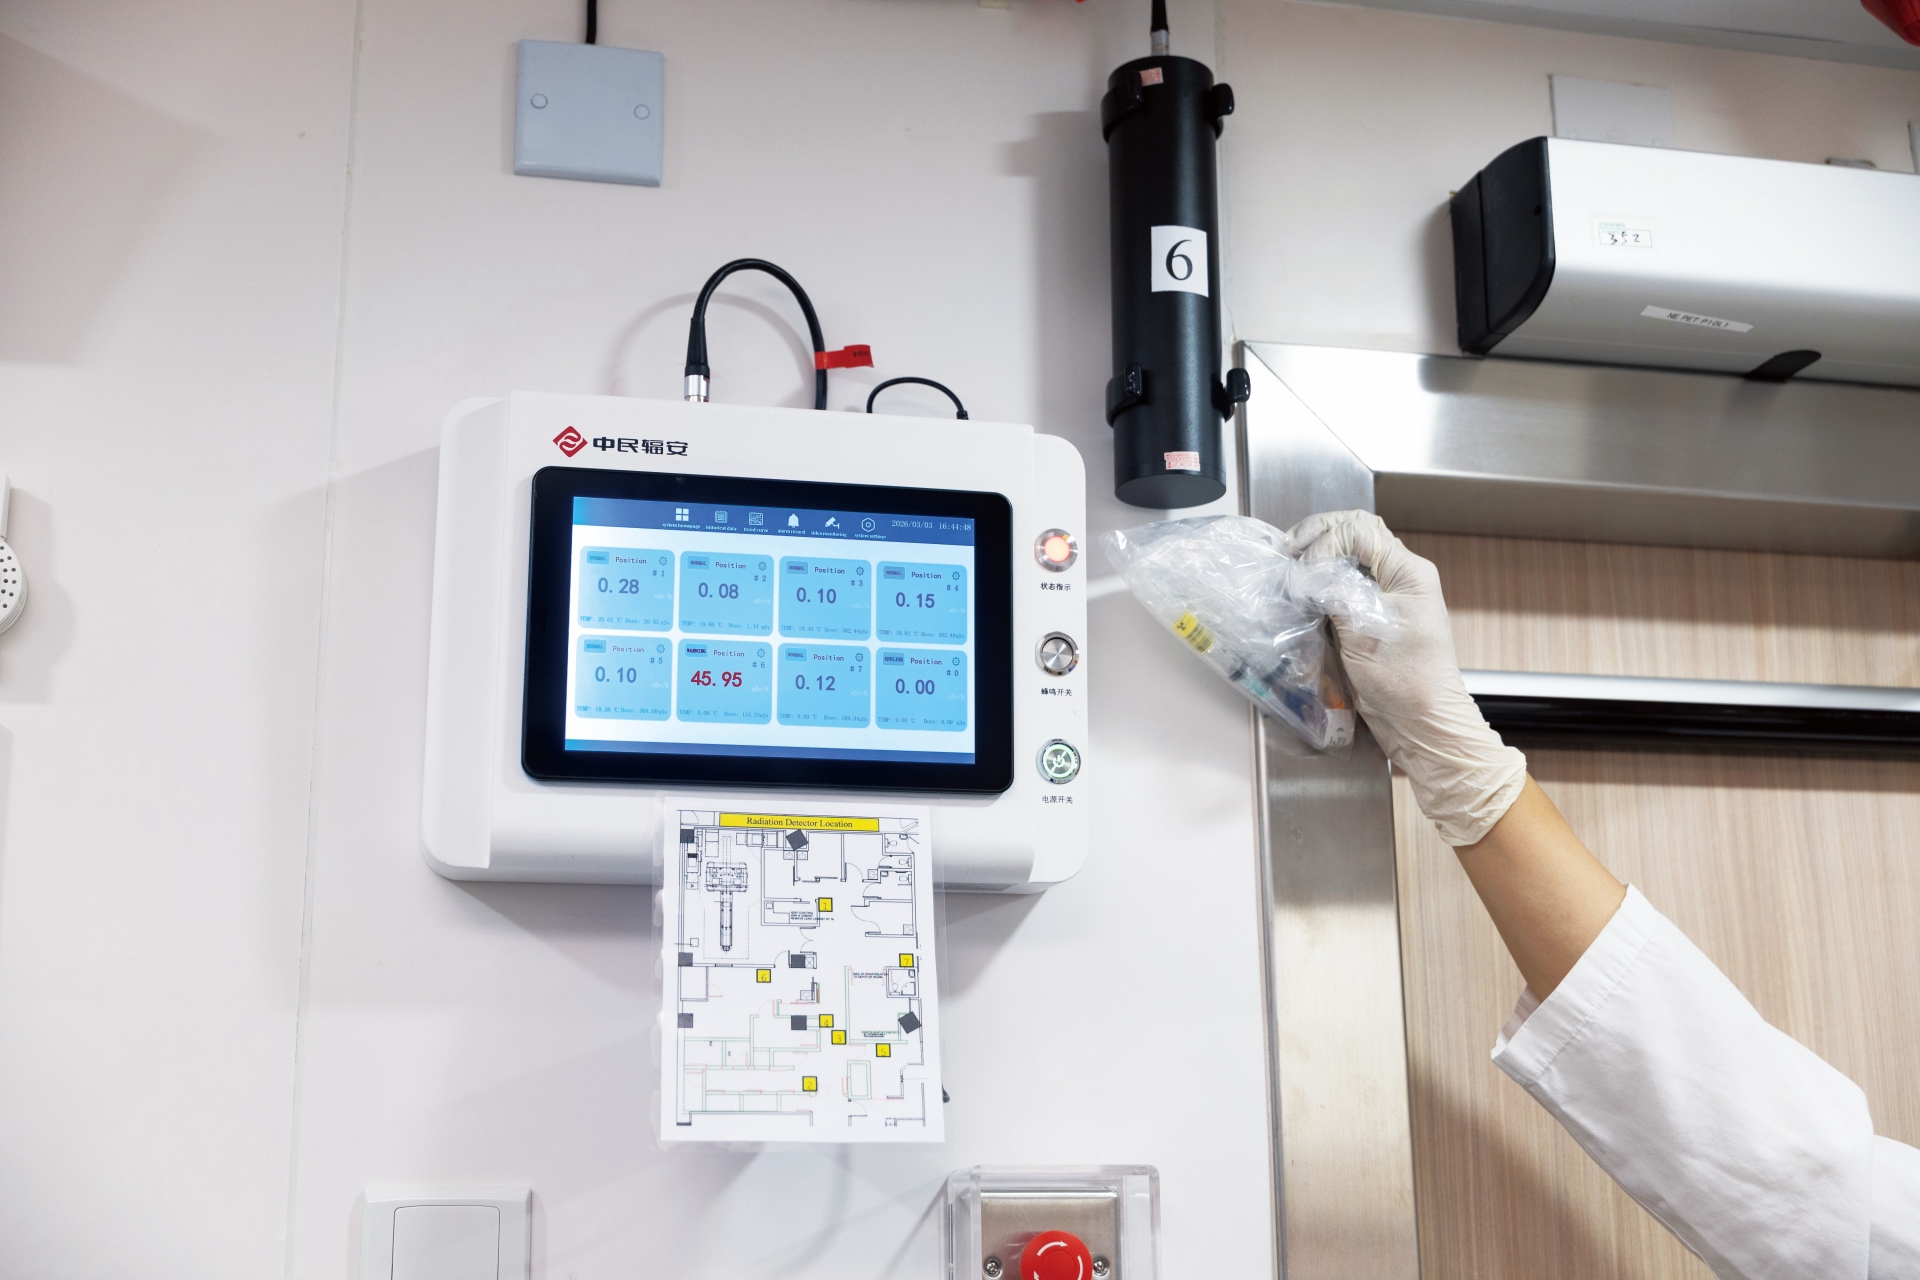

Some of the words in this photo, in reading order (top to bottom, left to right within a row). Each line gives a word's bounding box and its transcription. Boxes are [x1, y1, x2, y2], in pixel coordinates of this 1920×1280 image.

[1166, 239, 1193, 281] 6
[1680, 314, 1699, 322] PET
[593, 437, 688, 456] 中民辐安
[891, 520, 932, 529] 2026/03/03
[939, 523, 971, 531] 16:44:48
[598, 577, 639, 594] 0.28
[698, 582, 739, 599] 0.08
[1040, 582, 1071, 591] 状态指示
[796, 587, 836, 604] 0.10
[896, 592, 935, 608] 0.15
[595, 666, 637, 683] 0.10
[691, 671, 742, 687] 45.95
[795, 674, 835, 691] 0.12
[895, 679, 935, 695] 0.00
[1041, 687, 1072, 697] 蜂鸣开关
[1042, 795, 1073, 804] 电源开关
[747, 817, 783, 826] Radiation
[786, 819, 817, 827] Detector
[762, 974, 766, 982] 6
[824, 1019, 828, 1027] 4
[881, 1048, 886, 1056] 5
[807, 1081, 812, 1089] 2
